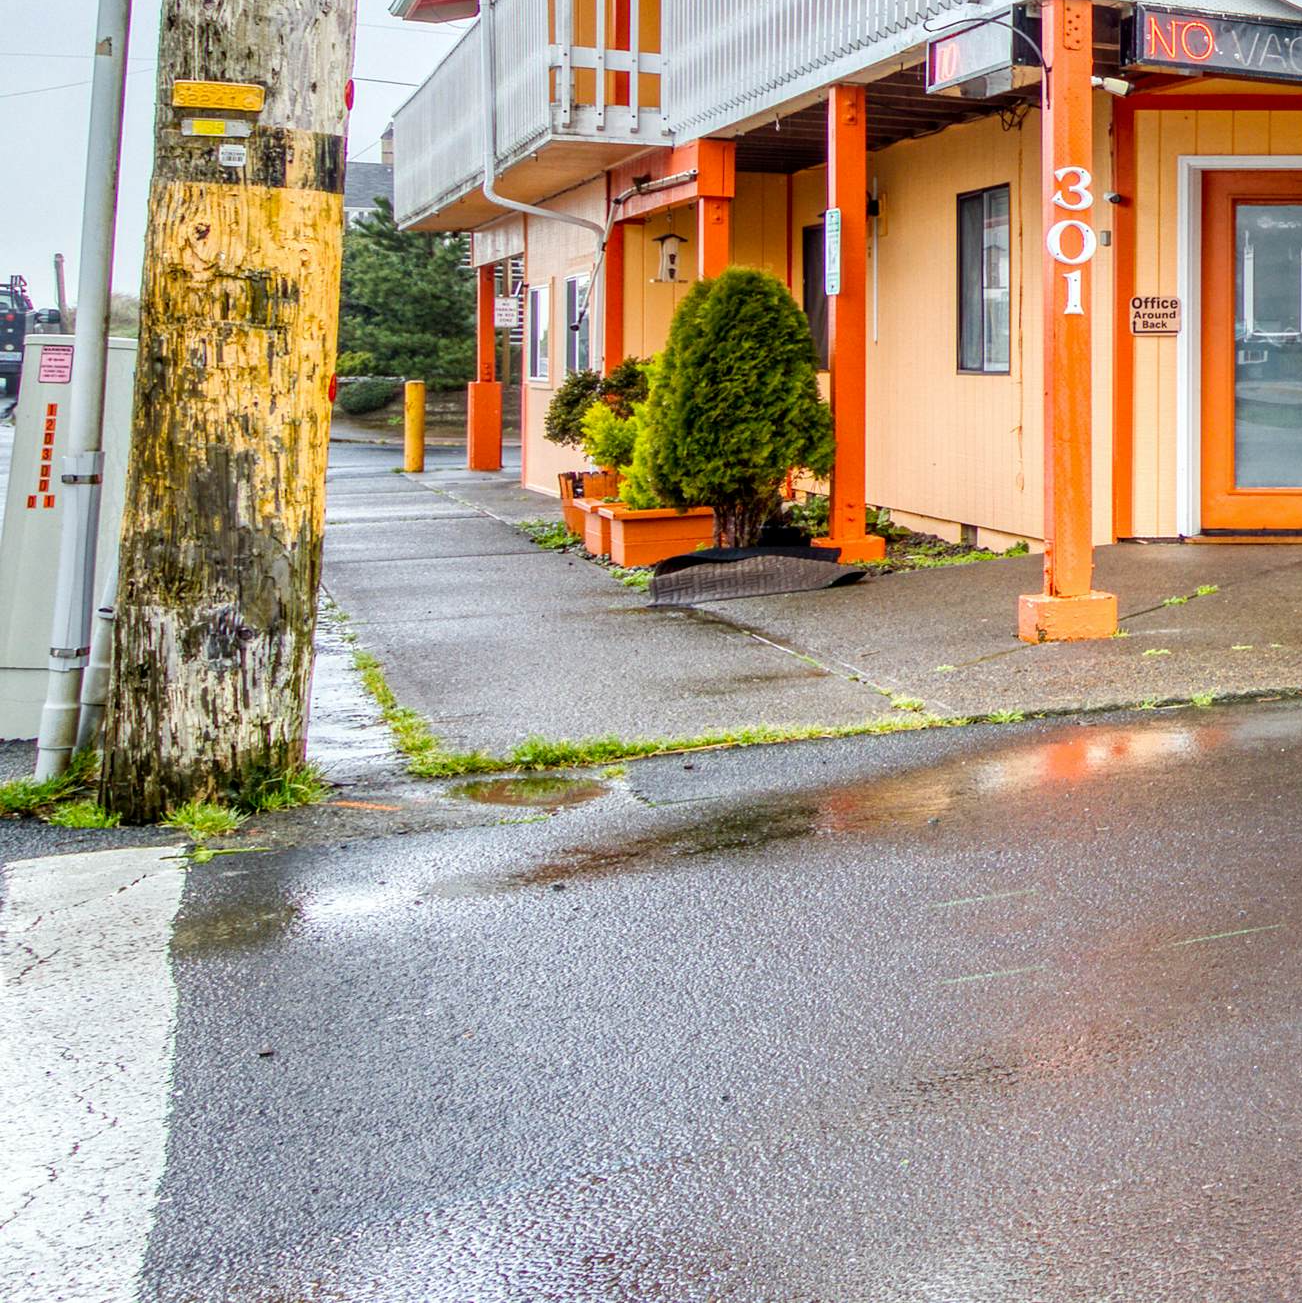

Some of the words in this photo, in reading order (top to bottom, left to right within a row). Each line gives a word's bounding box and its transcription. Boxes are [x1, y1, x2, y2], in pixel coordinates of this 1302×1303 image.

[1147, 17, 1214, 61] NO
[1046, 165, 1098, 316] 301
[1131, 297, 1178, 309] Office
[1134, 311, 1176, 319] Around
[1142, 320, 1168, 329] Back
